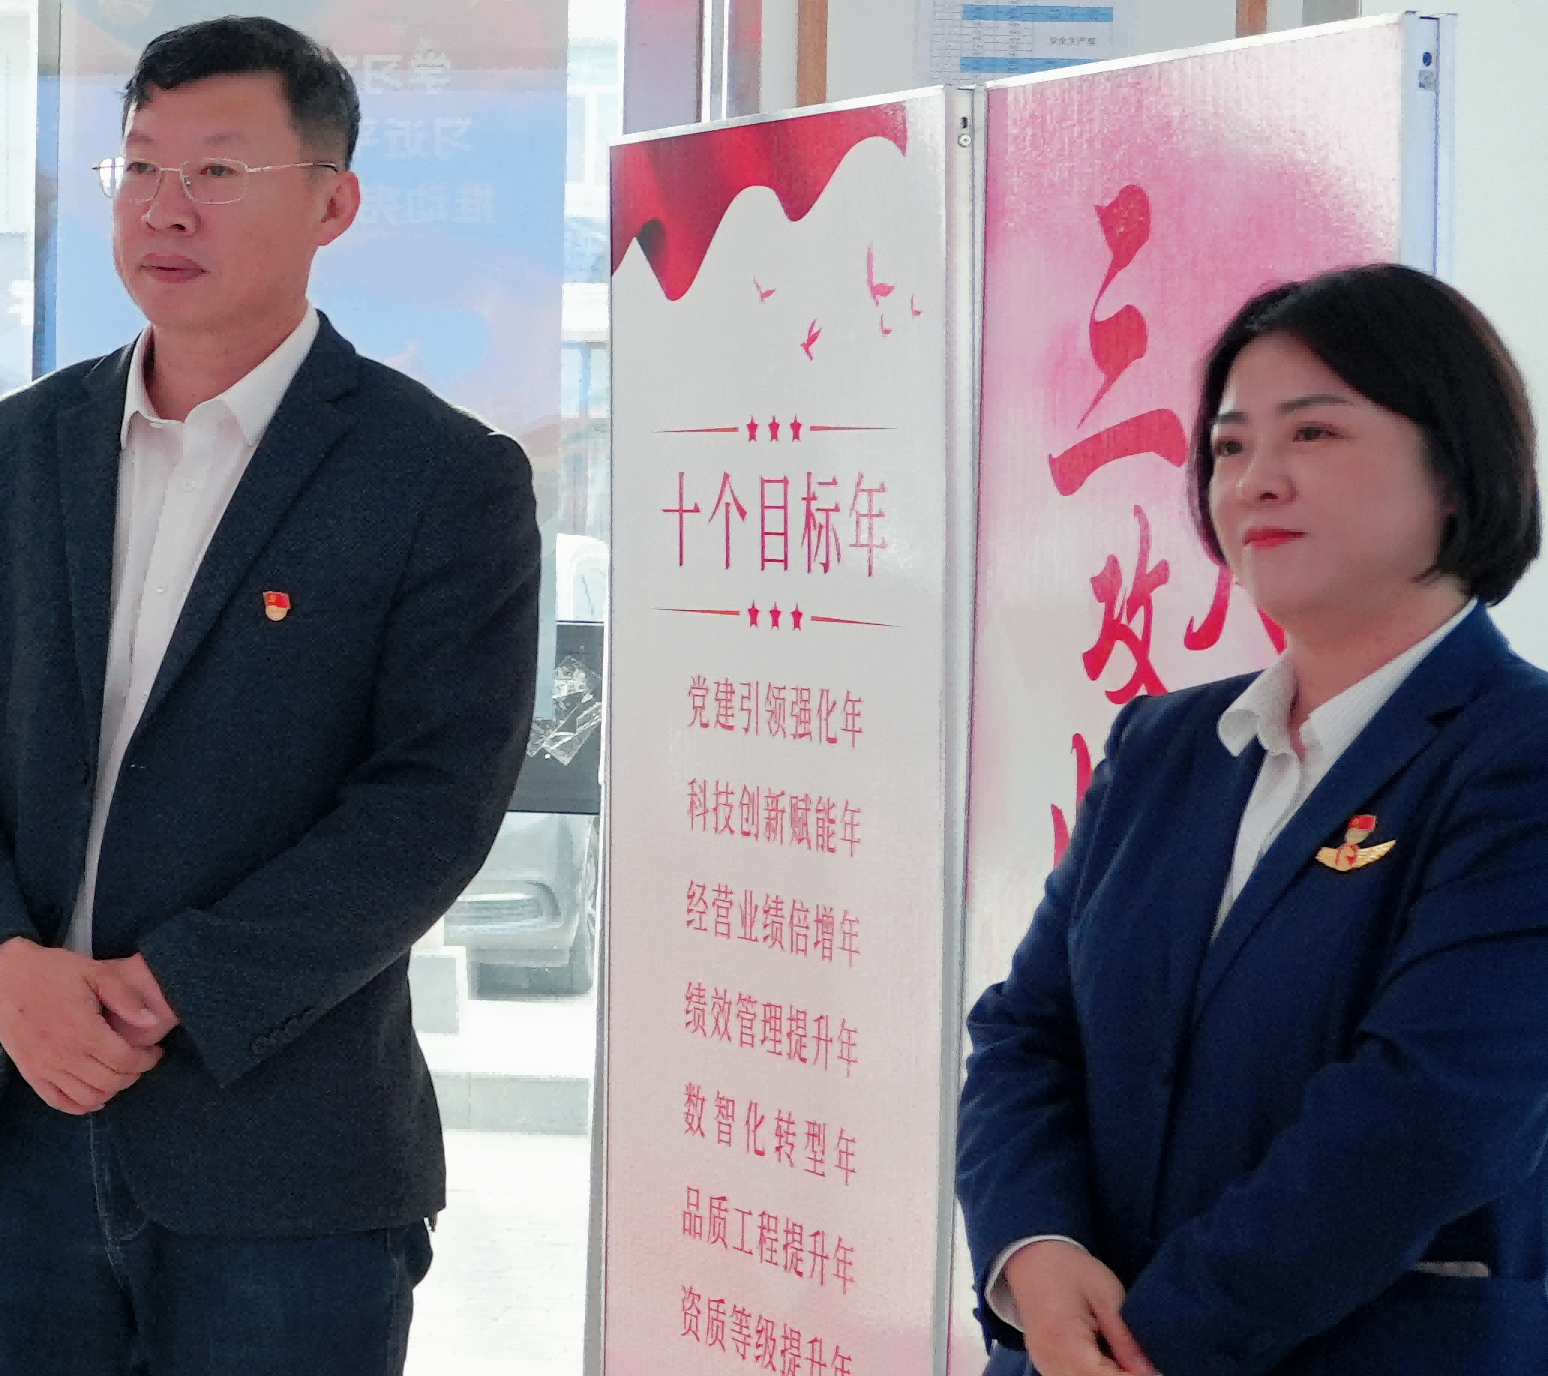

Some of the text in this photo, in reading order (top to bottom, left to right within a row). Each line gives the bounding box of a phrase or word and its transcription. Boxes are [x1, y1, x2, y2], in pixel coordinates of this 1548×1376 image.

[661, 470, 889, 578] 十个目标年
[686, 674, 864, 749] 党建引领强化年
[686, 776, 863, 858] 科技创新赋能年
[685, 879, 862, 969] 经营业绩倍增年
[683, 980, 859, 1079] 绩效管理提升年
[682, 1082, 857, 1187] 数智化转型年
[682, 1184, 856, 1295] 品质工程提升年
